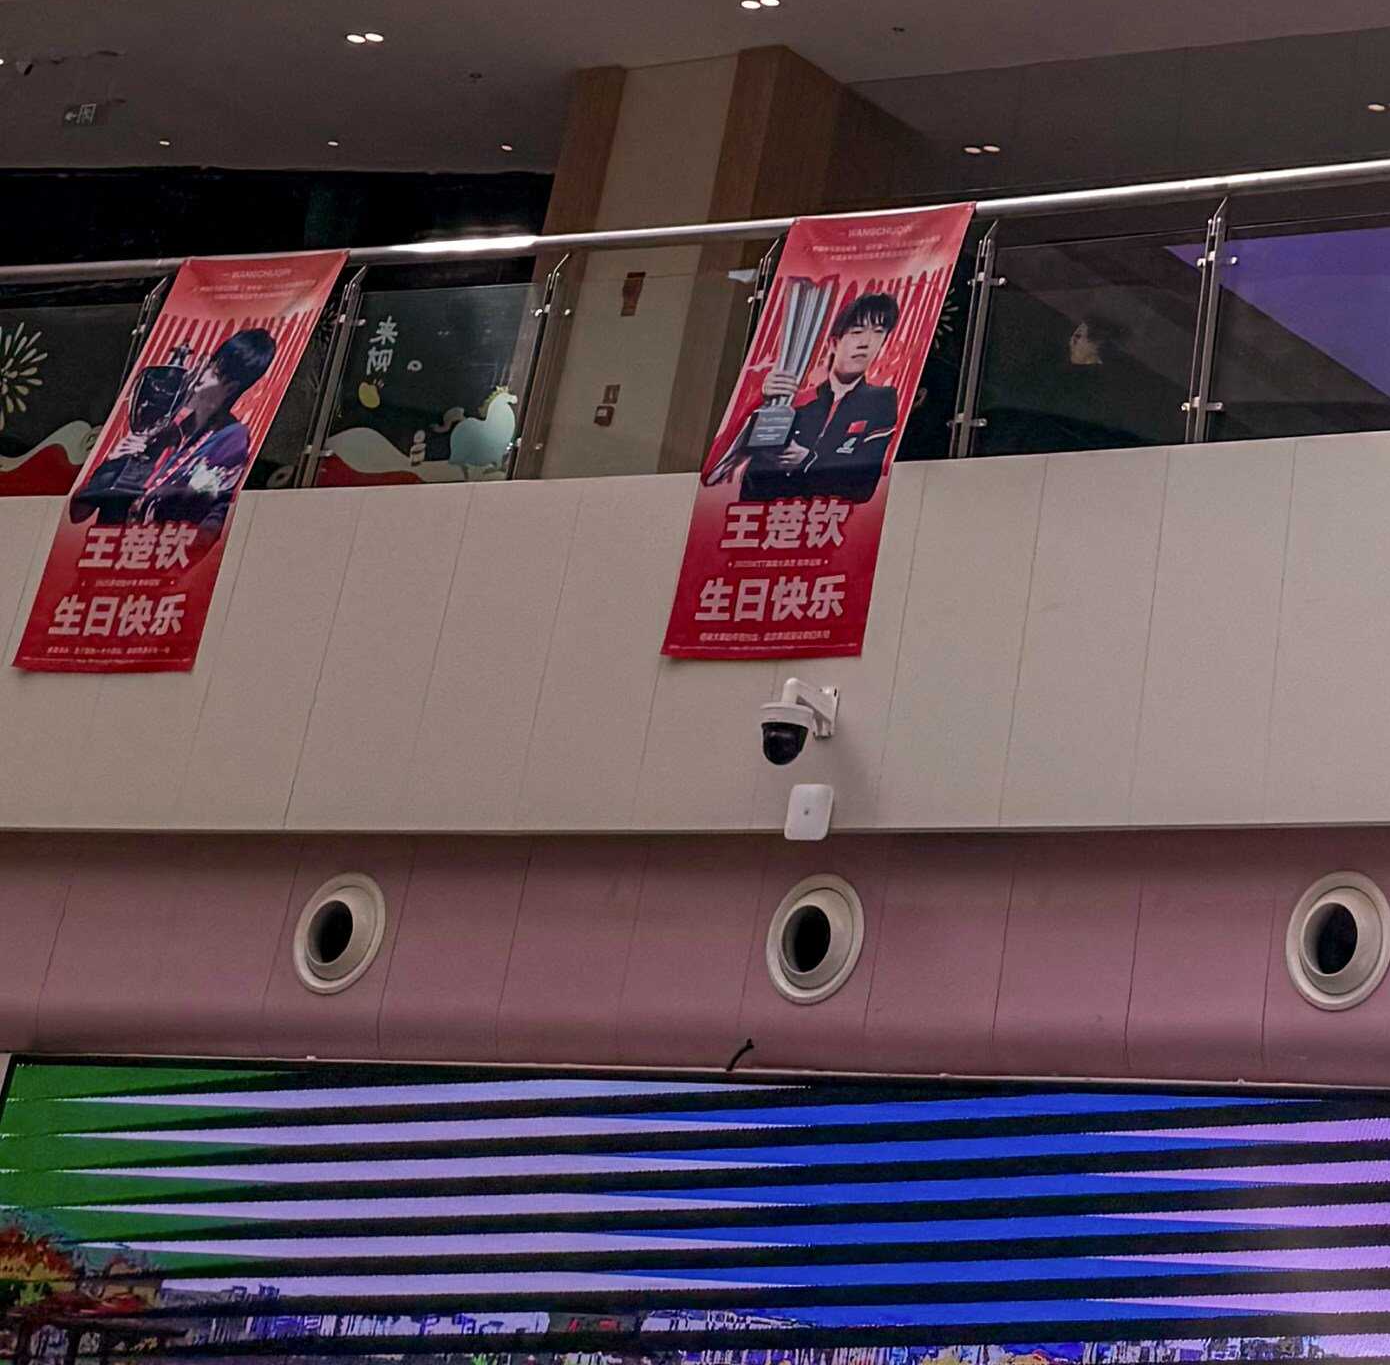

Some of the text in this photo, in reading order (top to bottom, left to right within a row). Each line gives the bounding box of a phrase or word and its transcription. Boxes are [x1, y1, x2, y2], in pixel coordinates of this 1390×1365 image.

[77, 523, 198, 570] 王楚钦
[720, 499, 850, 551] 王楚钦
[47, 593, 187, 637] 生日快乐
[694, 574, 846, 622] 生日快乐
